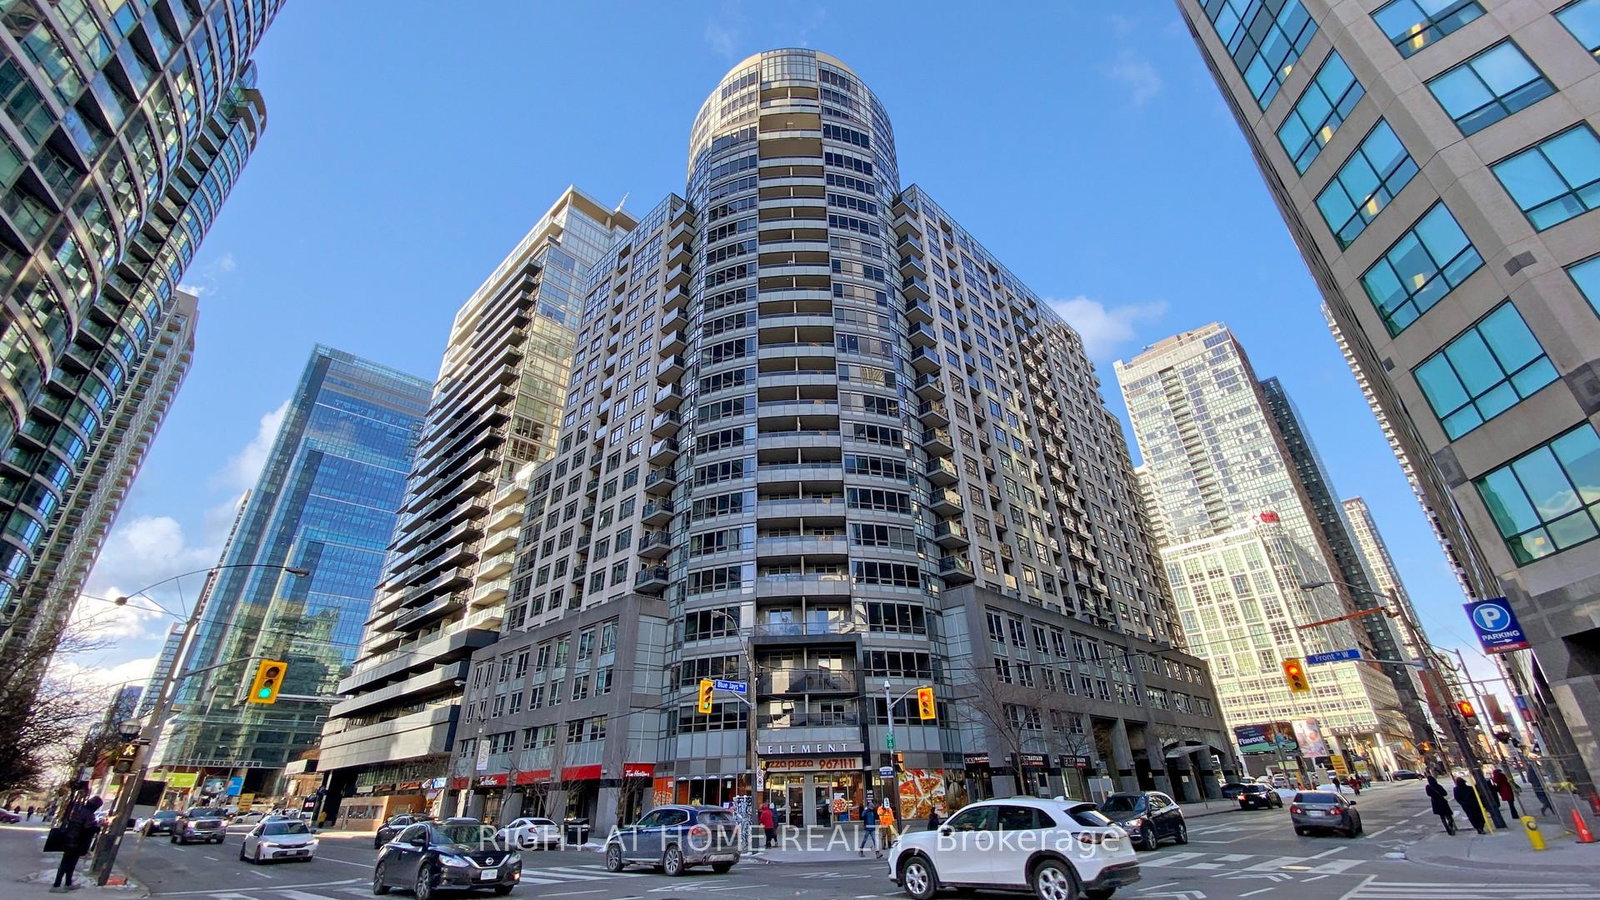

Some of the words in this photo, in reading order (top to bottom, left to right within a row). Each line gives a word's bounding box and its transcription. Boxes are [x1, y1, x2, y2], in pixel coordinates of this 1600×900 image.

[1480, 608, 1501, 628] P
[1482, 630, 1520, 641] PARKING
[1314, 653, 1336, 662] Front
[717, 681, 728, 689] Blue
[729, 682, 739, 691] Jays
[767, 743, 848, 755] ELEMENT
[788, 759, 814, 770] pizza
